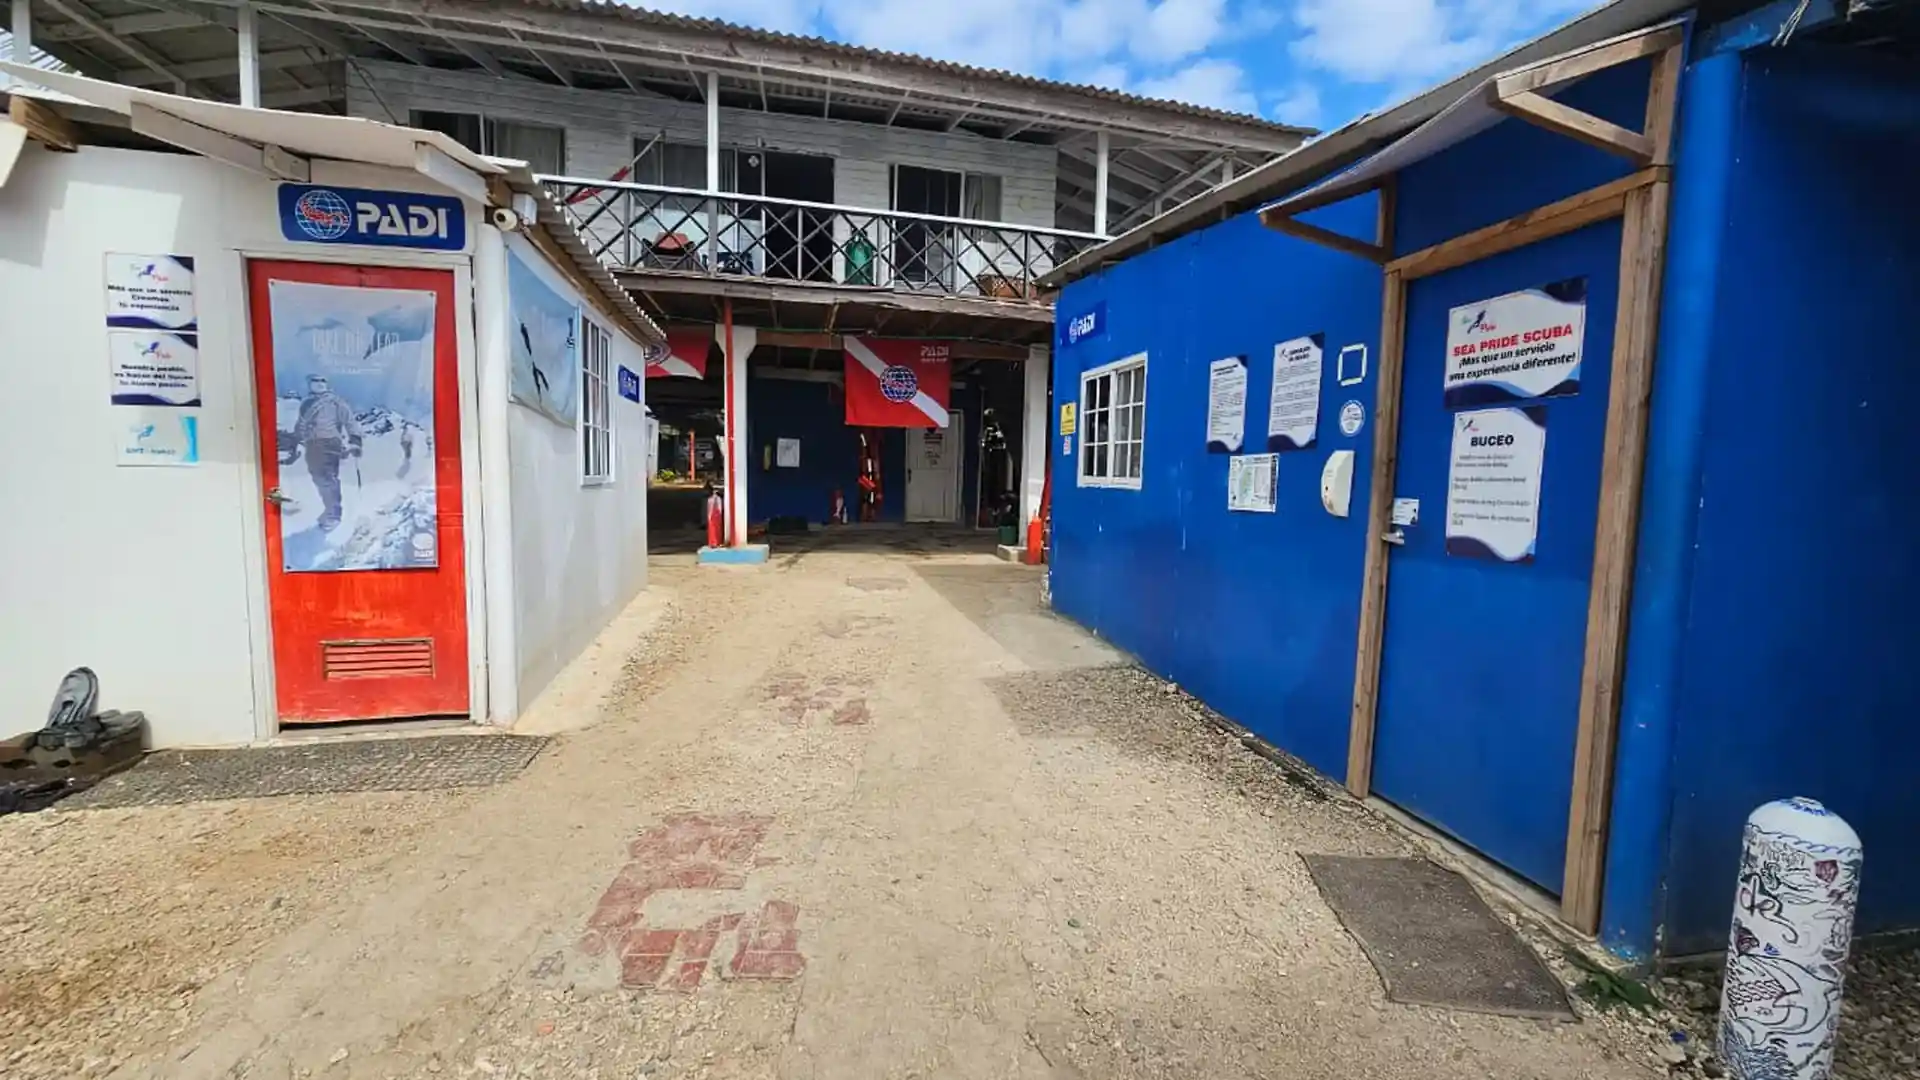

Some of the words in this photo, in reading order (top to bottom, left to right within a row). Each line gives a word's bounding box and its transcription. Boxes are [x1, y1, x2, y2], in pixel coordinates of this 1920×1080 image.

[356, 202, 447, 239] PADI
[1077, 312, 1096, 337] PADI
[920, 346, 949, 357] PADI
[1452, 343, 1477, 358] SEA
[1479, 334, 1520, 353] PRIDE
[1522, 323, 1573, 344] SCUBA
[1467, 361, 1520, 381] experiencia
[1522, 352, 1577, 371] diferente!
[1481, 353, 1500, 366] que
[1500, 350, 1514, 360] un
[1515, 342, 1556, 358] servicio
[1470, 434, 1515, 447] BUCEO
